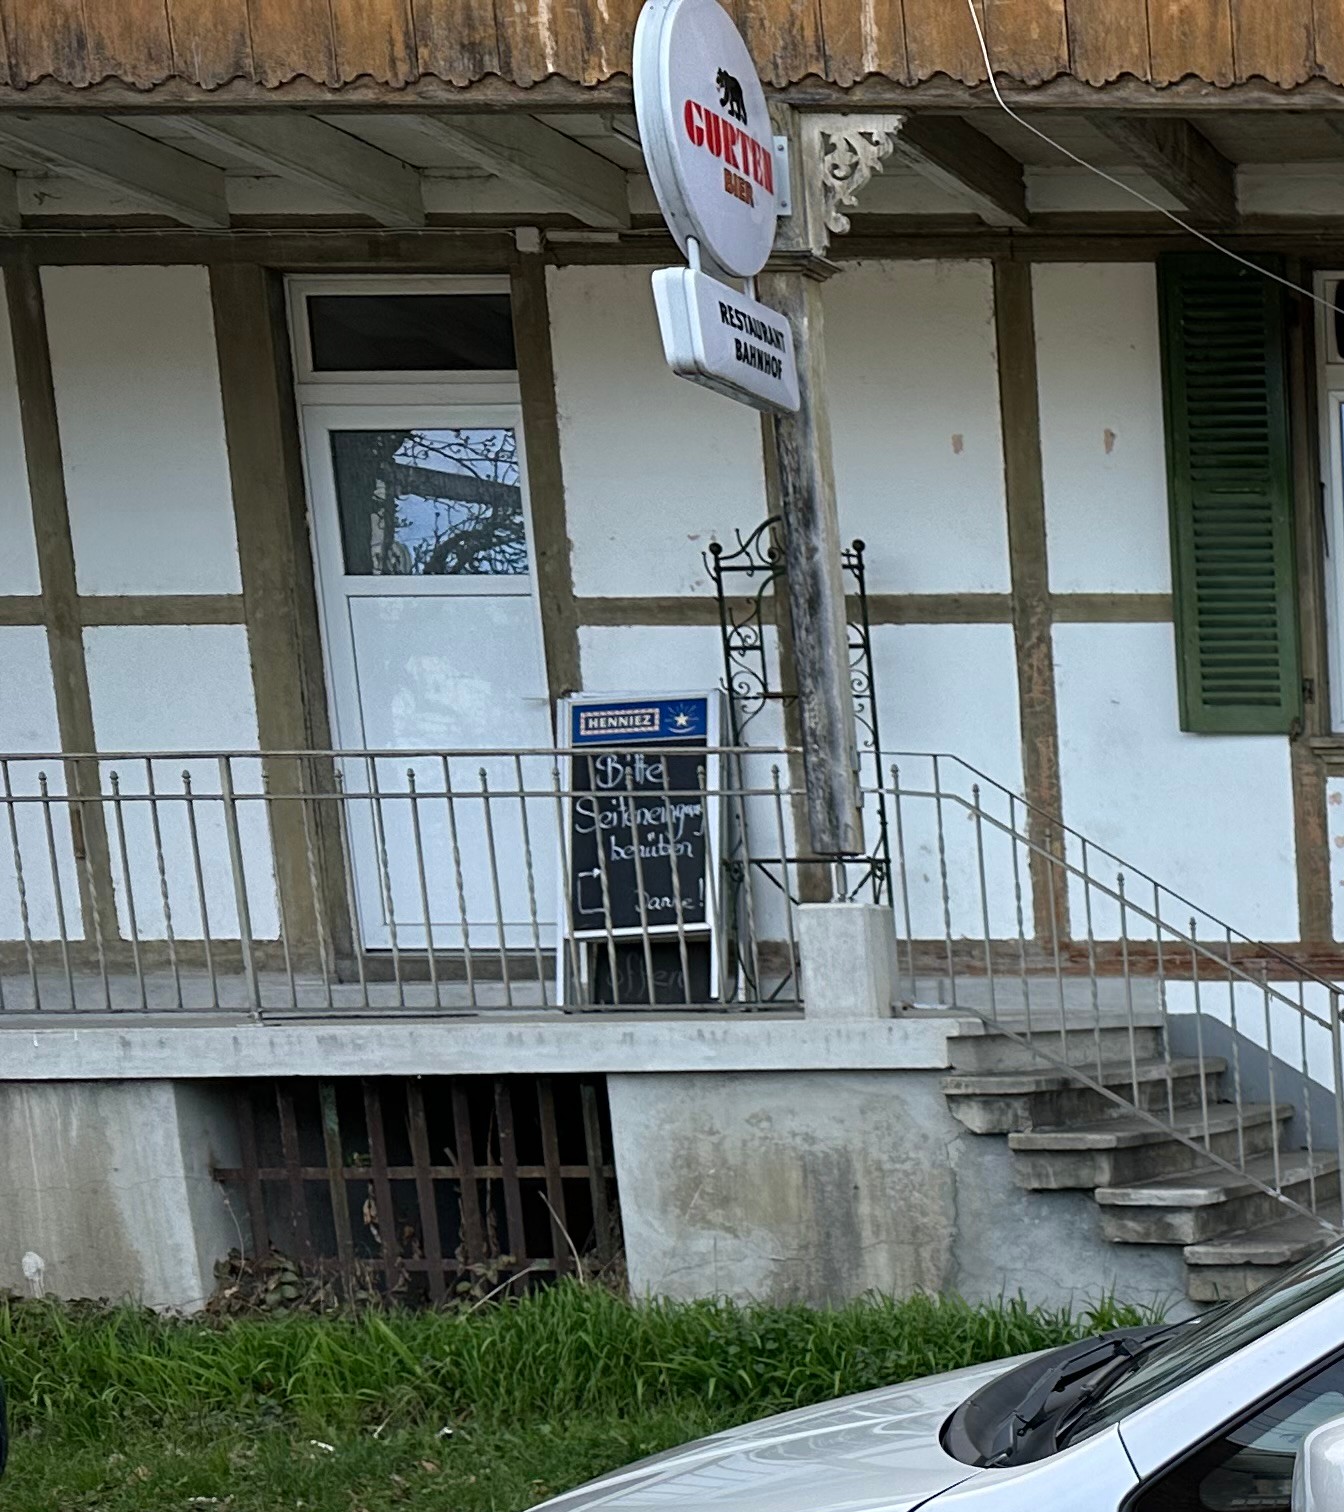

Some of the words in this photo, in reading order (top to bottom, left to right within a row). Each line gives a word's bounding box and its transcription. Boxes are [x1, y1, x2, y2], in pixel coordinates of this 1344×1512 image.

[684, 99, 774, 195] GURTEN
[723, 167, 755, 208] BIER
[718, 300, 786, 353] RESTAURANT
[734, 337, 782, 380] BAHNHOF
[588, 714, 652, 729] HENNIEZ
[595, 754, 669, 789] Bitte
[634, 878, 704, 912] Dane!
